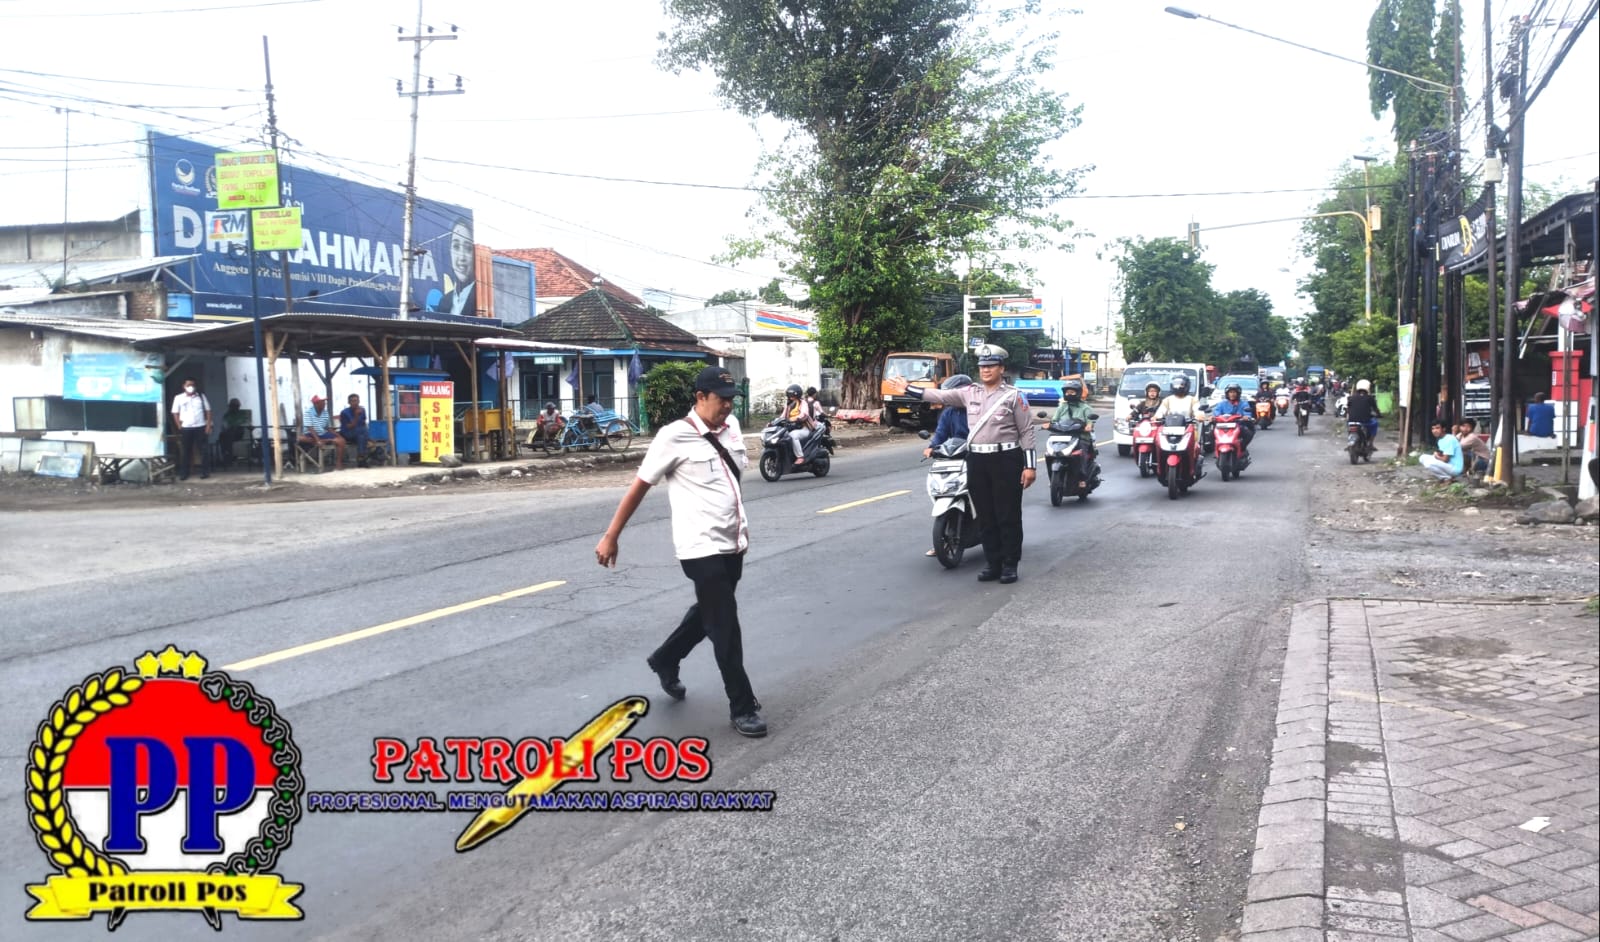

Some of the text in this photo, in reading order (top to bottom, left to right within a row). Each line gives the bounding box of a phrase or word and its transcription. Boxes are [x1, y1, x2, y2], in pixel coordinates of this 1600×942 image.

[289, 272, 310, 283] omisi
[422, 385, 450, 395] MALANG
[432, 401, 441, 458] STMJ
